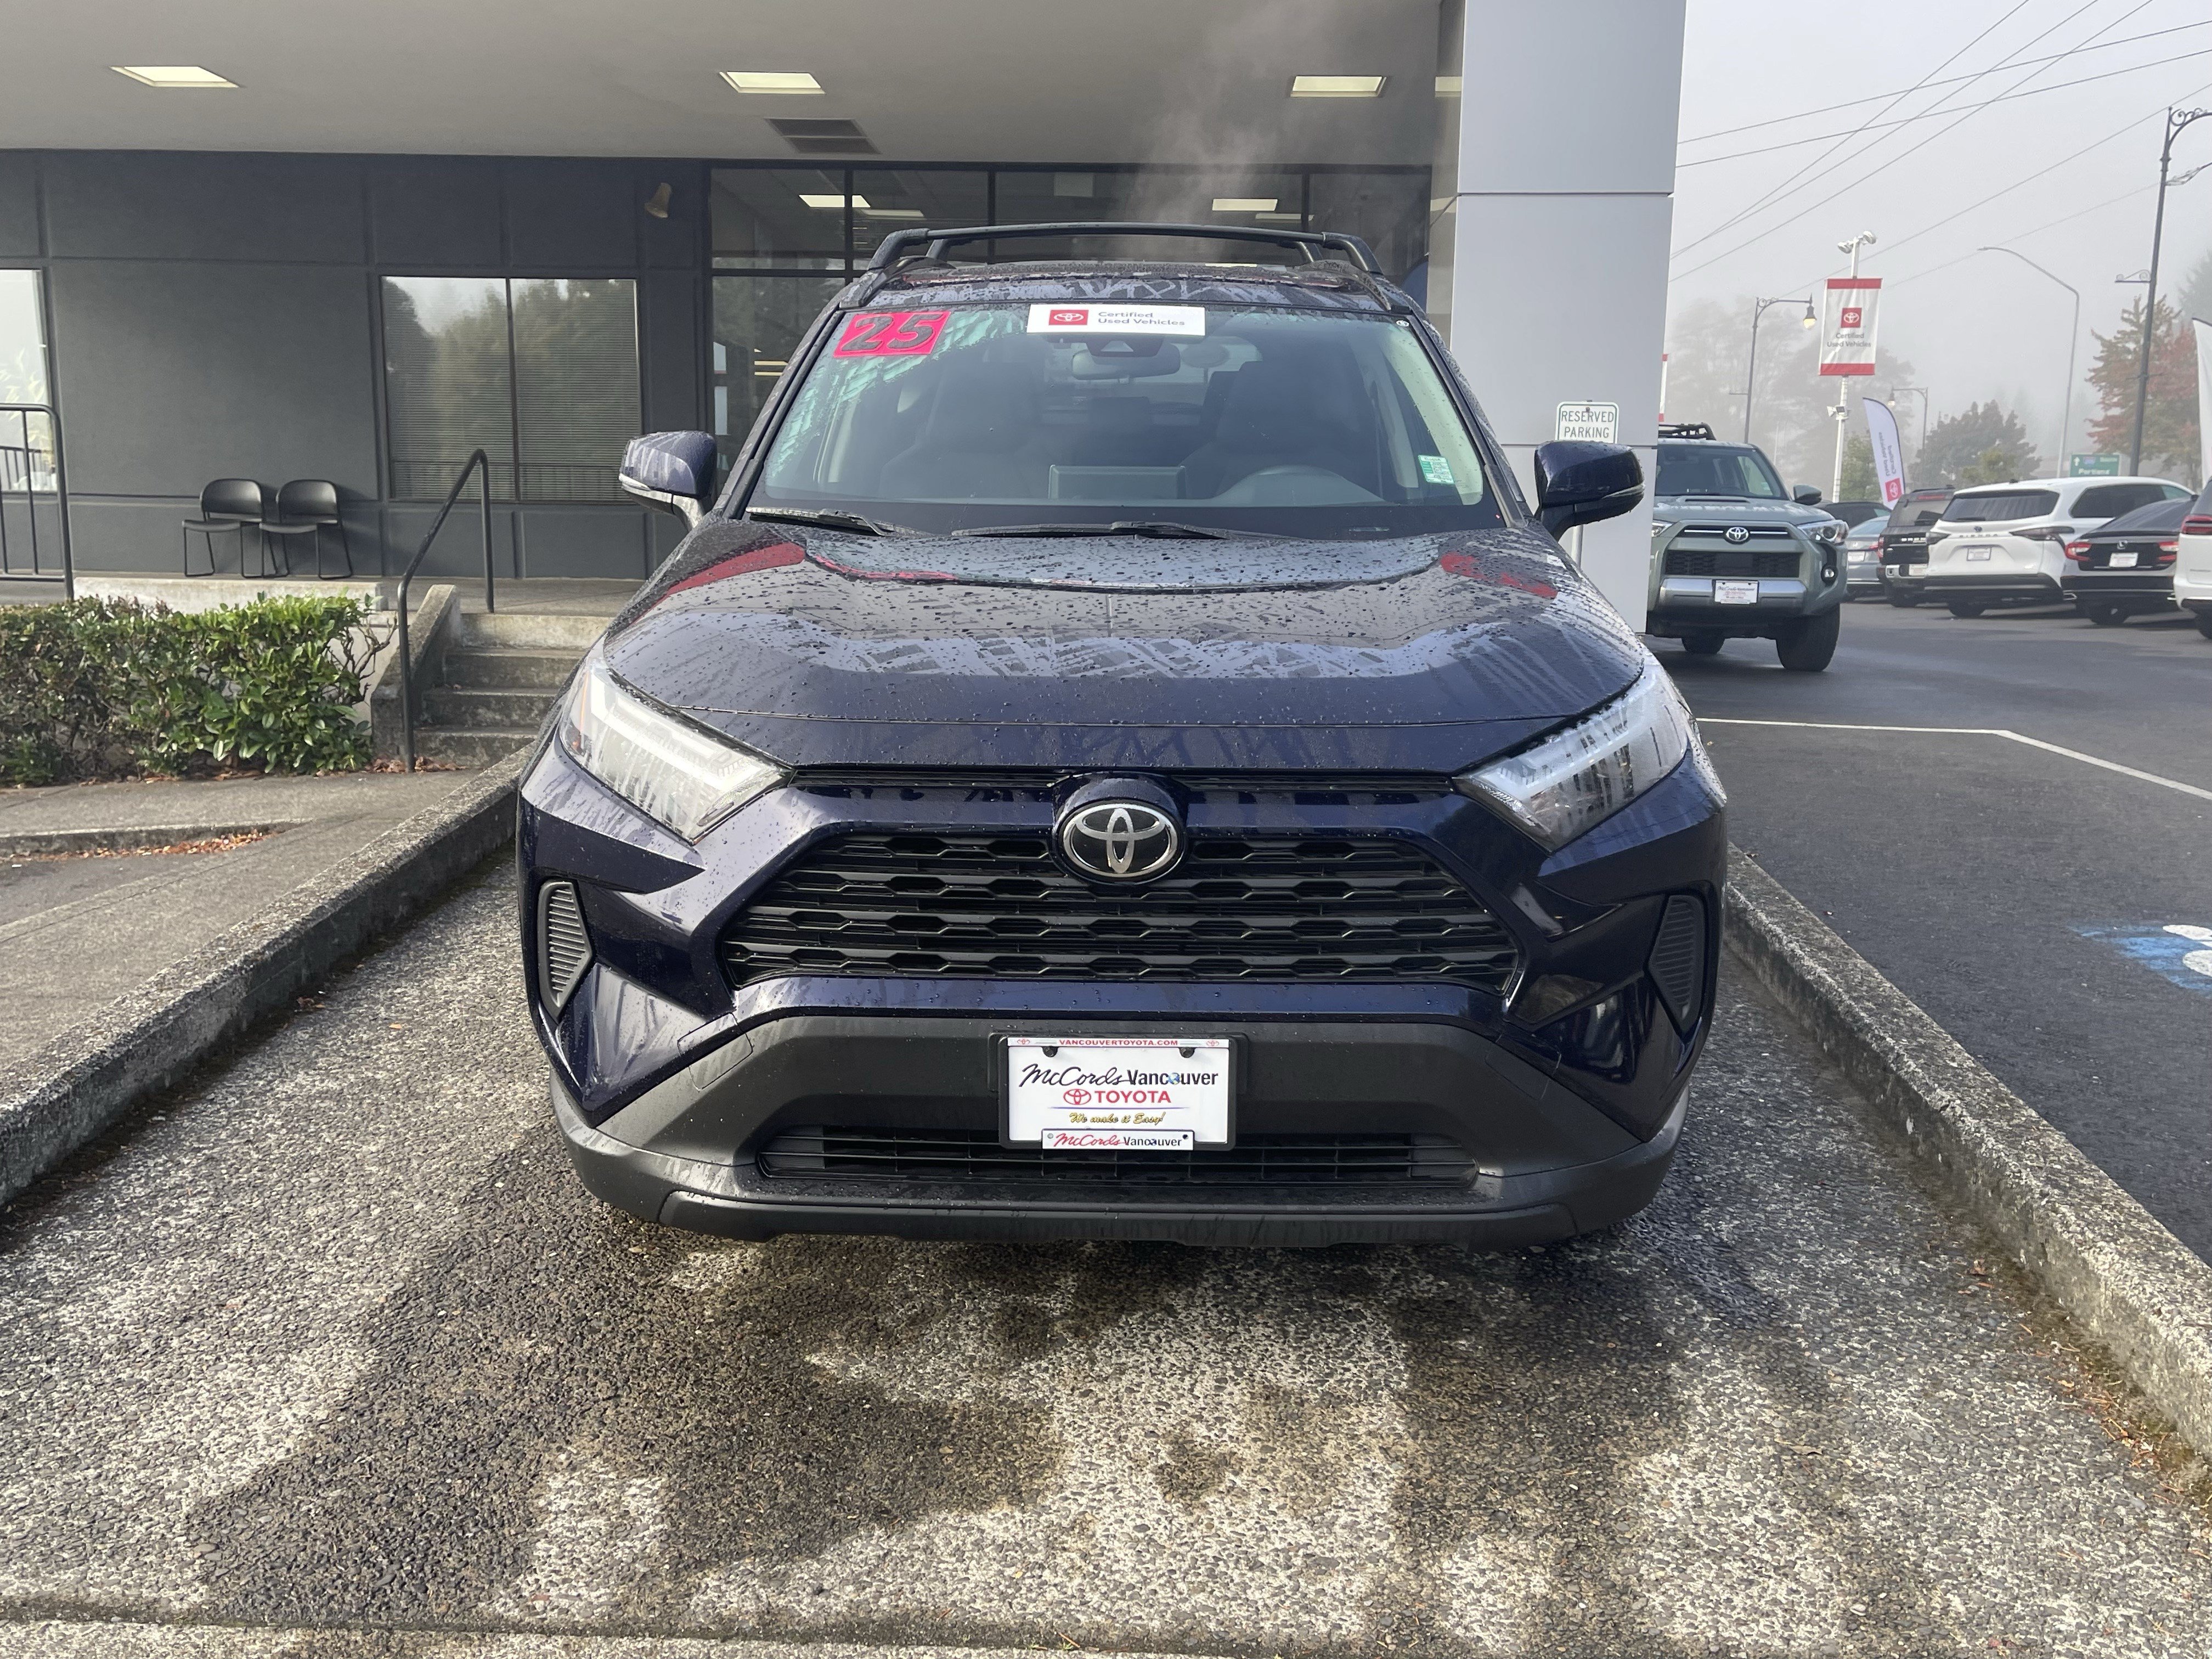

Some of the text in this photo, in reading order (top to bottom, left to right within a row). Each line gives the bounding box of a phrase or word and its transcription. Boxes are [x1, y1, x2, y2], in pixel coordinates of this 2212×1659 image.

[1133, 318, 1185, 326] Vehicles
[841, 314, 944, 351] 25
[1561, 410, 1614, 422] RESERVED
[1564, 426, 1610, 438] PARKING
[1094, 1090, 1172, 1103] TOYOTA
[1069, 1111, 1166, 1126] We make it Easy!
